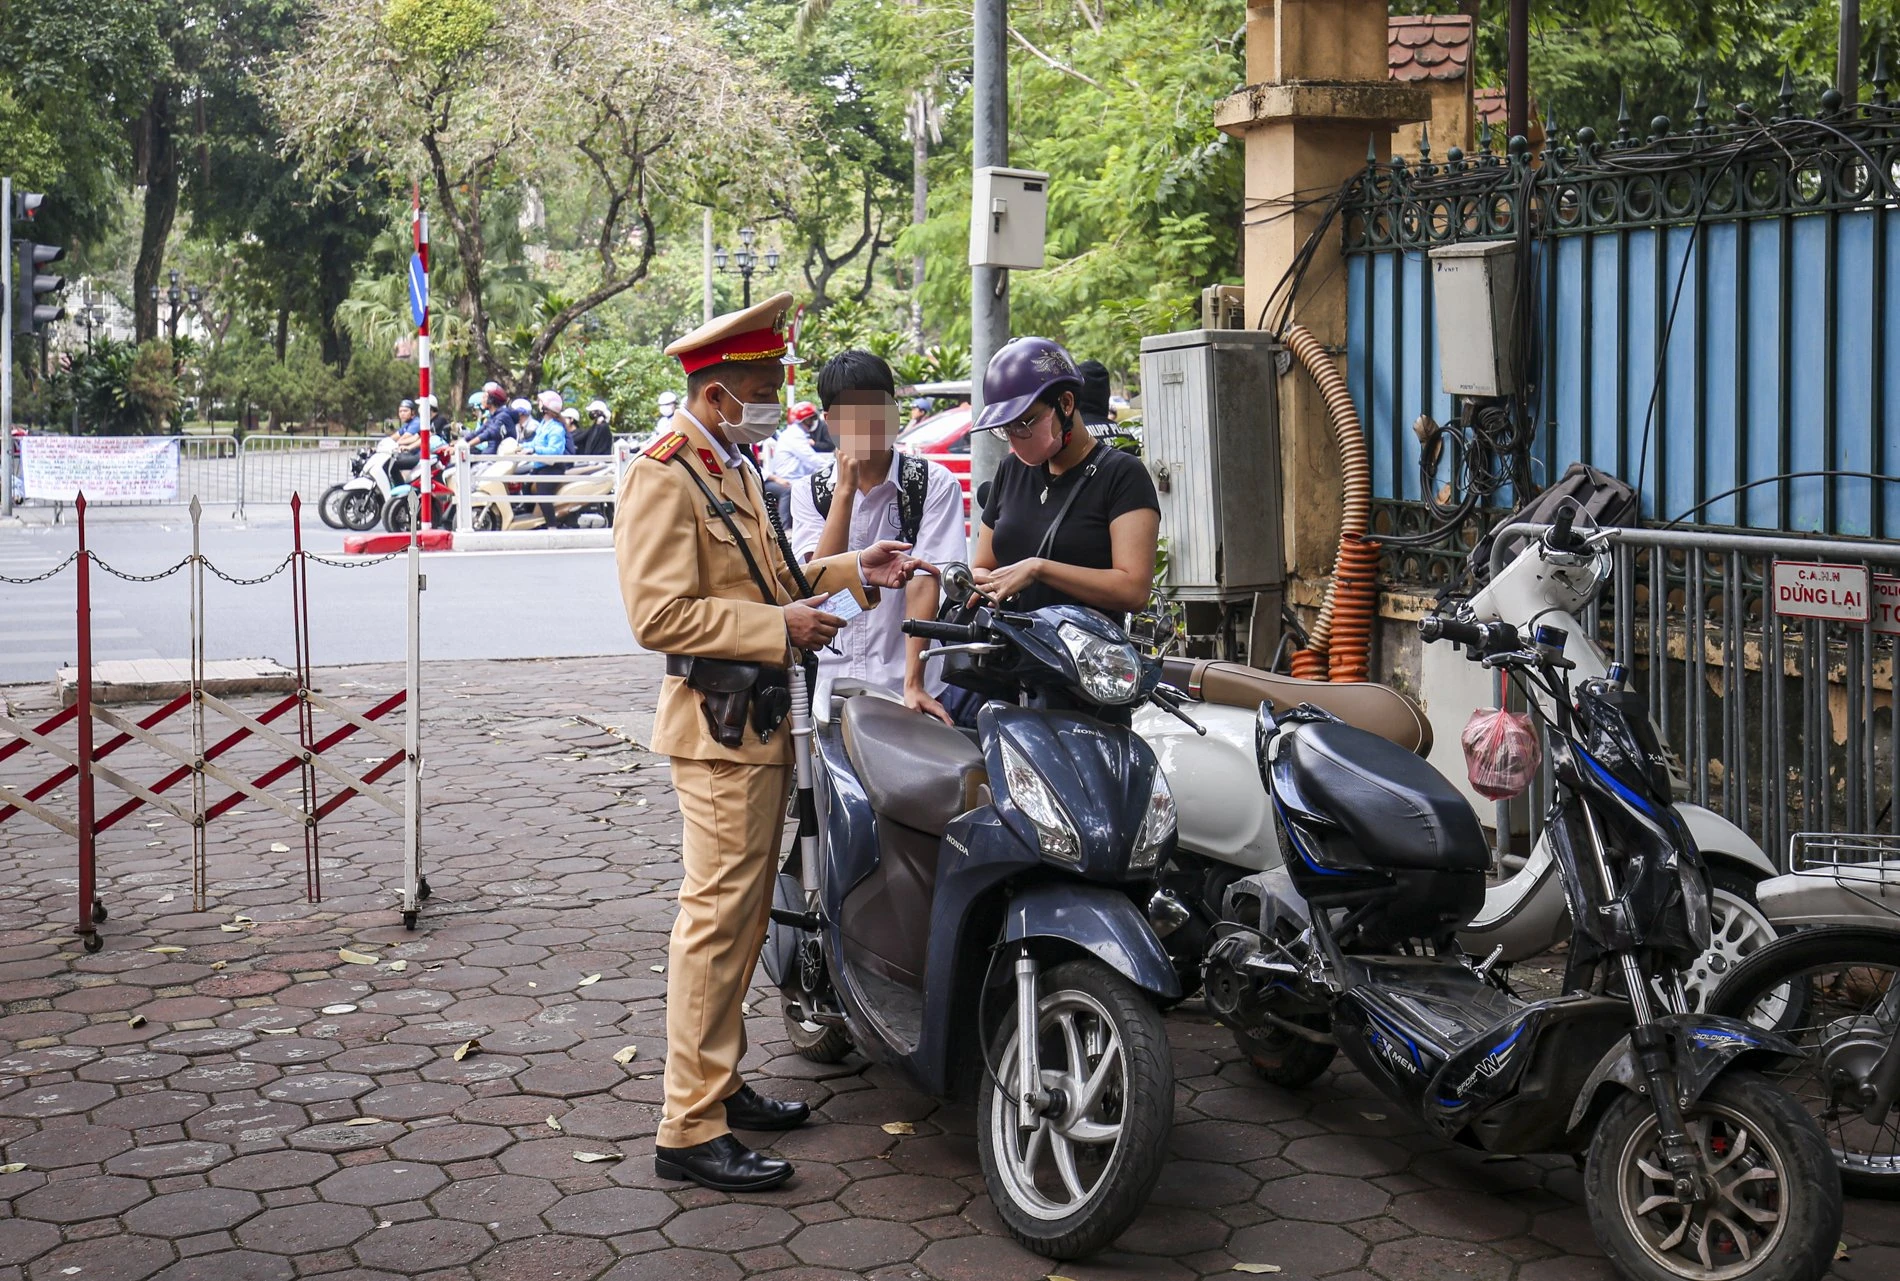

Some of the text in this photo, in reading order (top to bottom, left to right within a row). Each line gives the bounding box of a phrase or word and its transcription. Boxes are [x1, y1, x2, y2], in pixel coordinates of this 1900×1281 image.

[1780, 581, 1861, 610] DỪNG LẠI
[1873, 584, 1900, 596] POLI
[946, 833, 969, 857] HONDA
[1391, 1051, 1417, 1074] MEN
